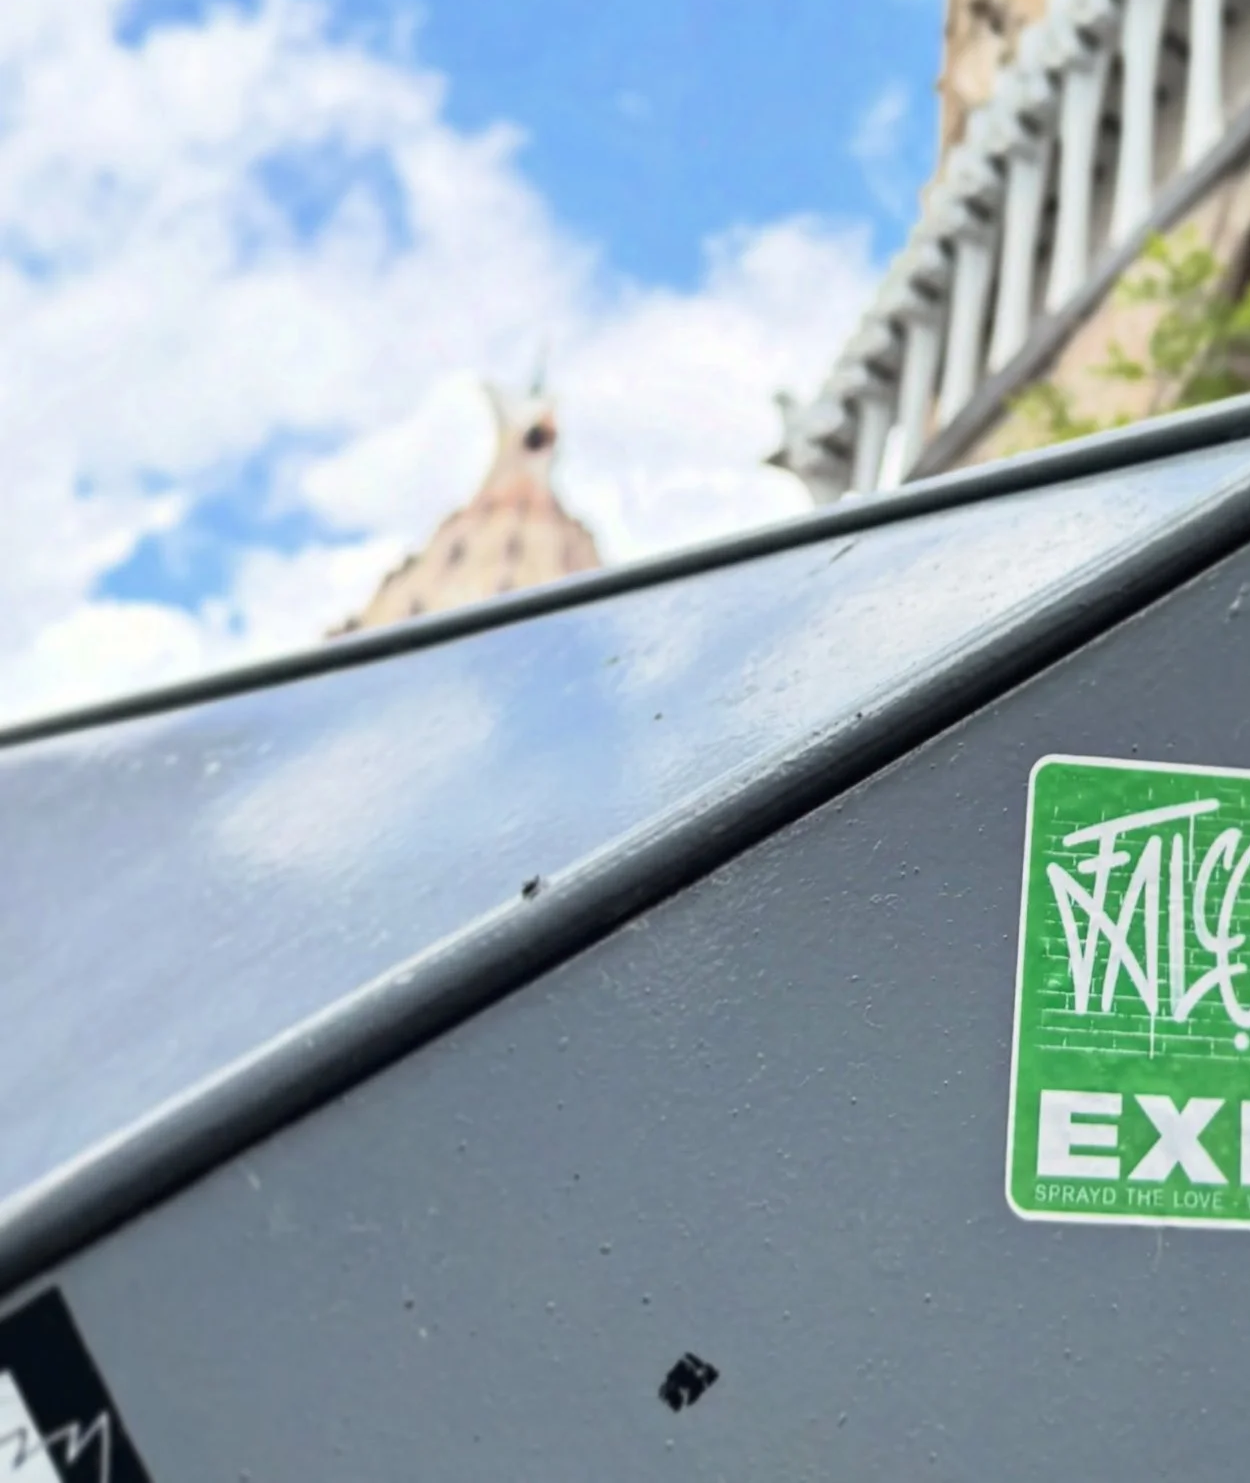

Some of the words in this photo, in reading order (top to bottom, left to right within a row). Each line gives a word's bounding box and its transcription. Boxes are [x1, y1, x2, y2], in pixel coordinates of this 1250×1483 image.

[1034, 1183, 1117, 1206] SPRAYD
[1126, 1187, 1165, 1208] THE
[1172, 1190, 1224, 1210] LOVE
